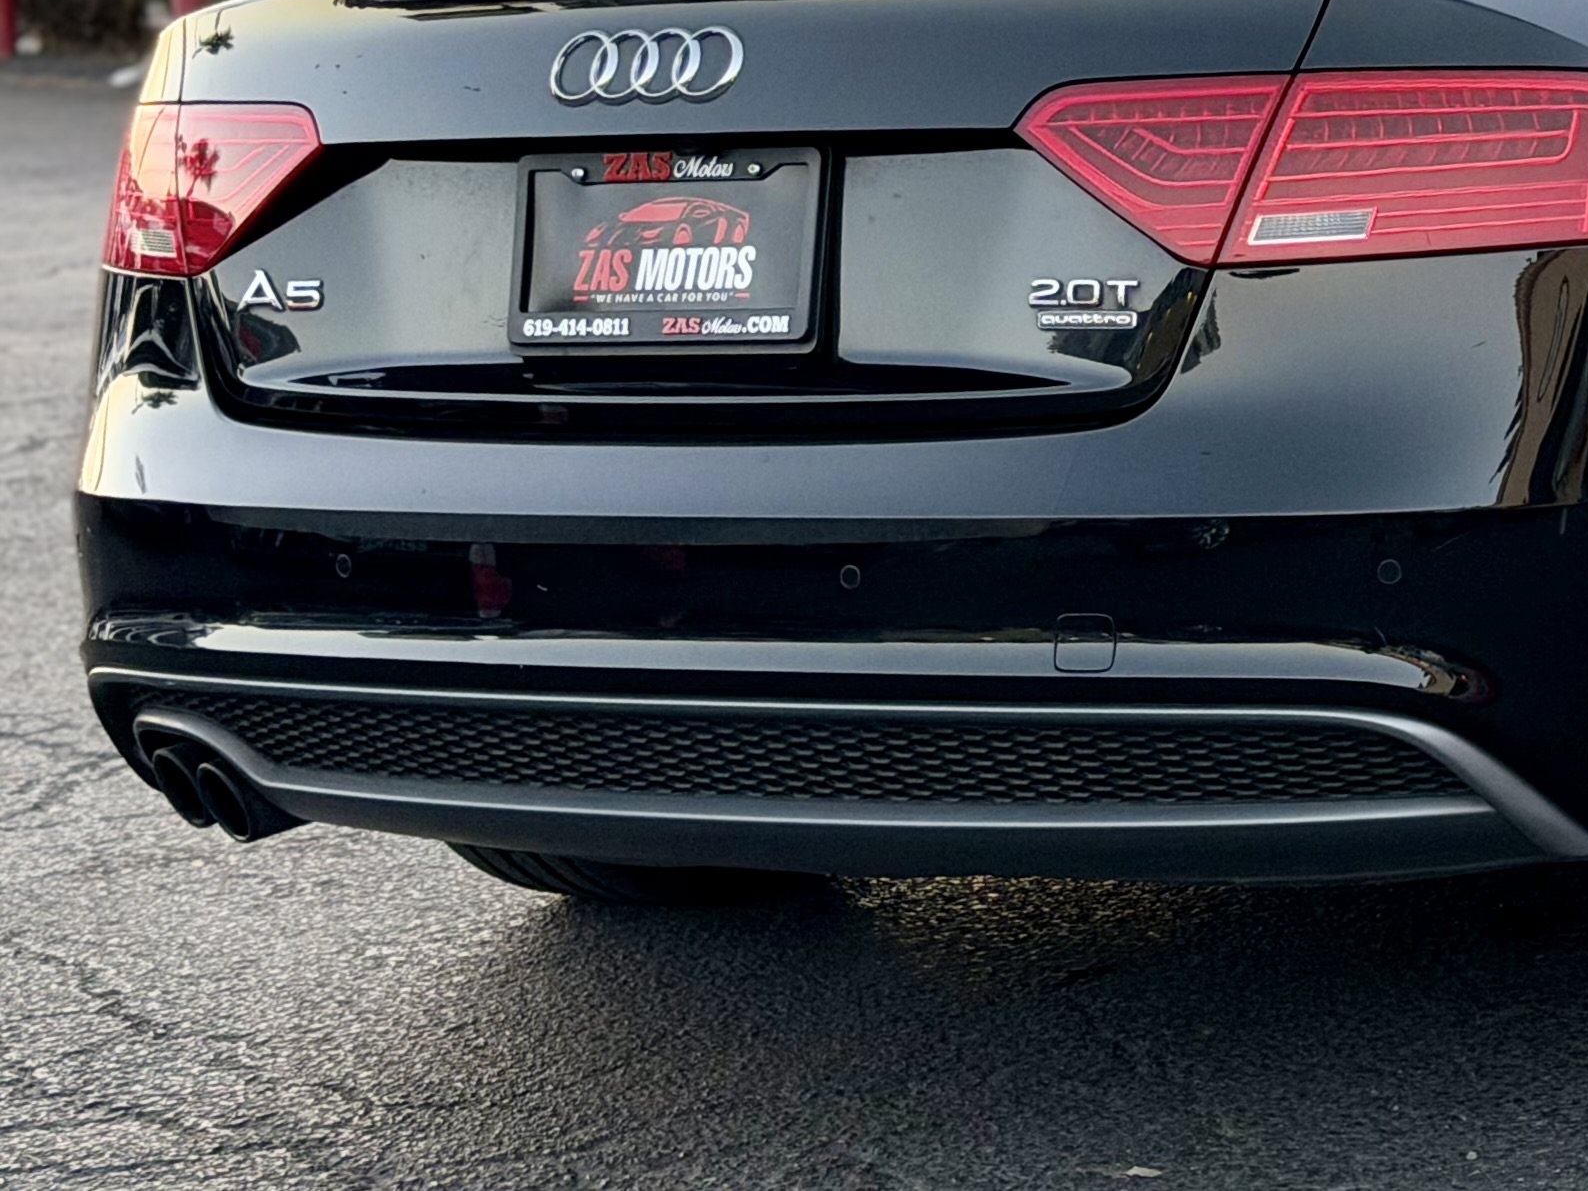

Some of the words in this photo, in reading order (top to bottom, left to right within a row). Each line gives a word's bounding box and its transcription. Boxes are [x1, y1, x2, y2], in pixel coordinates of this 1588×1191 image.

[603, 151, 673, 182] ZAS
[673, 155, 734, 179] Motors
[573, 248, 634, 291] ZAS
[635, 245, 757, 291] MOTORS
[236, 269, 322, 310] A5
[615, 293, 644, 303] HAVE
[646, 293, 654, 302] A
[657, 293, 680, 303] CAR
[681, 292, 704, 303] FOR
[1028, 278, 1139, 307] 2.0T
[523, 317, 630, 337] 619-414-0811
[1040, 313, 1131, 325] quattro
